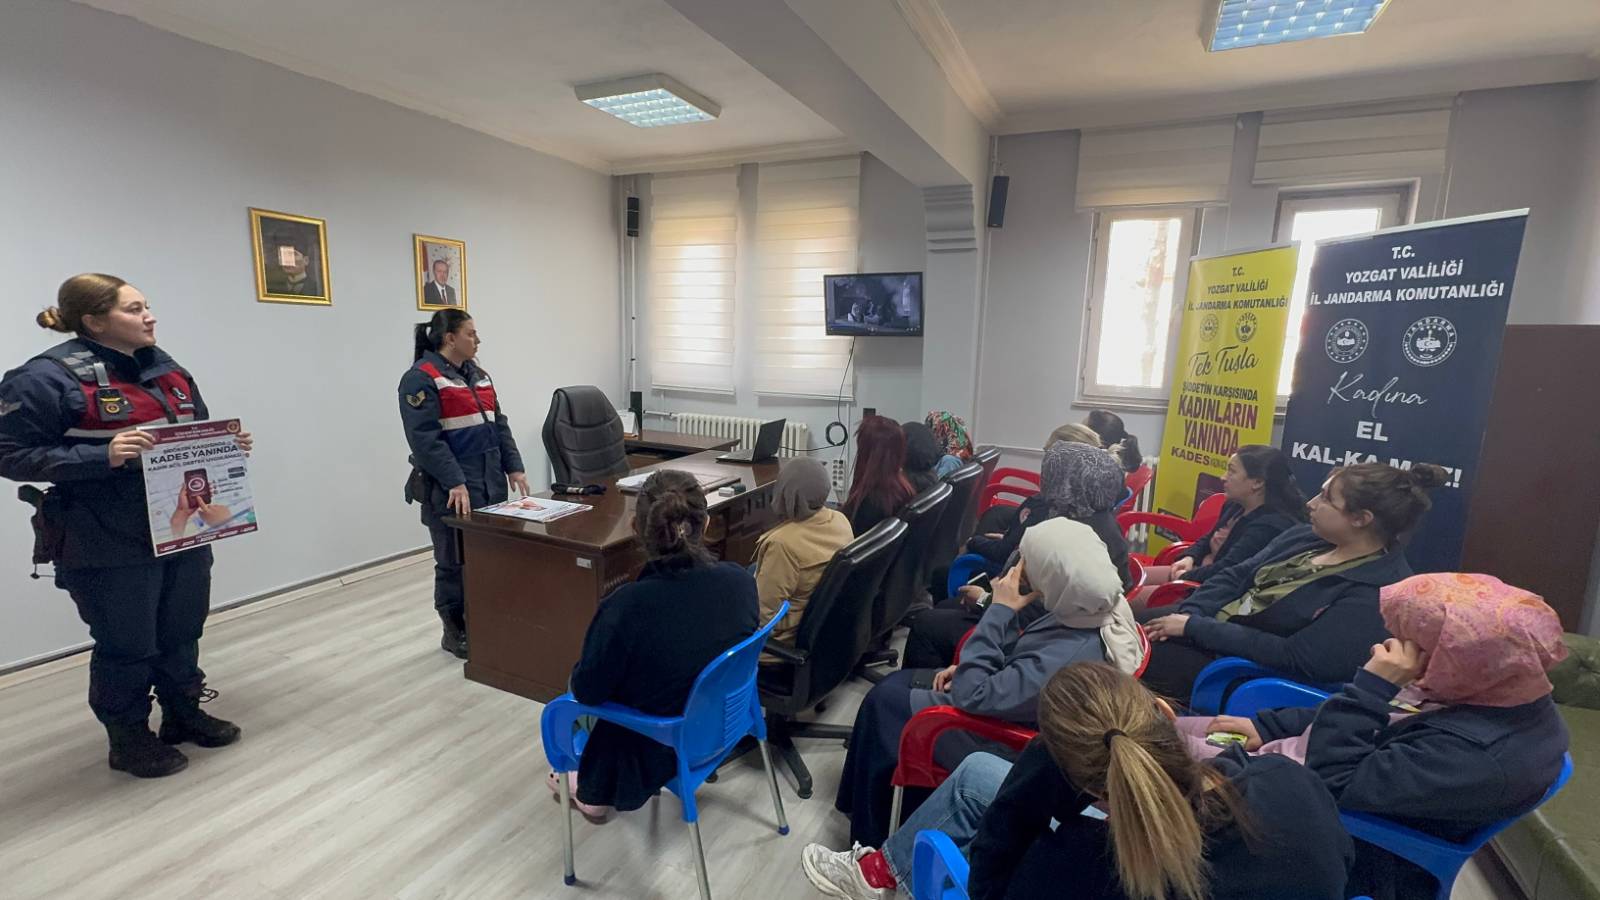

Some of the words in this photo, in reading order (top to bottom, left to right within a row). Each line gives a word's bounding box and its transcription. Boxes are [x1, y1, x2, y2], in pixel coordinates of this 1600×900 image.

[1391, 245, 1415, 260] T.C.
[1232, 266, 1245, 277] T.C.
[1345, 268, 1397, 285] YOZGAT
[1400, 259, 1463, 280] VALİLİĞİ
[1207, 283, 1235, 294] YOZGAT
[1236, 279, 1269, 292] VALİLİĞİ
[1310, 291, 1321, 305] İL
[1324, 289, 1391, 305] JANDARMA
[1396, 280, 1505, 302] KOMUTANLIĞI
[1233, 295, 1288, 309] KOMUTANLIĞI
[1189, 351, 1212, 377] Tek
[1215, 345, 1260, 375] Tuşla
[1182, 381, 1213, 396] ŞİDDETİN
[1213, 383, 1258, 401] KARŞISINDA
[1327, 371, 1428, 418] Kadına
[1177, 394, 1258, 430] KADINLARIN
[1183, 419, 1239, 458] YANINDA
[1356, 420, 1389, 442] EL
[150, 451, 189, 465] KADES
[191, 444, 238, 458] YANINDA
[1171, 446, 1210, 466] KADES
